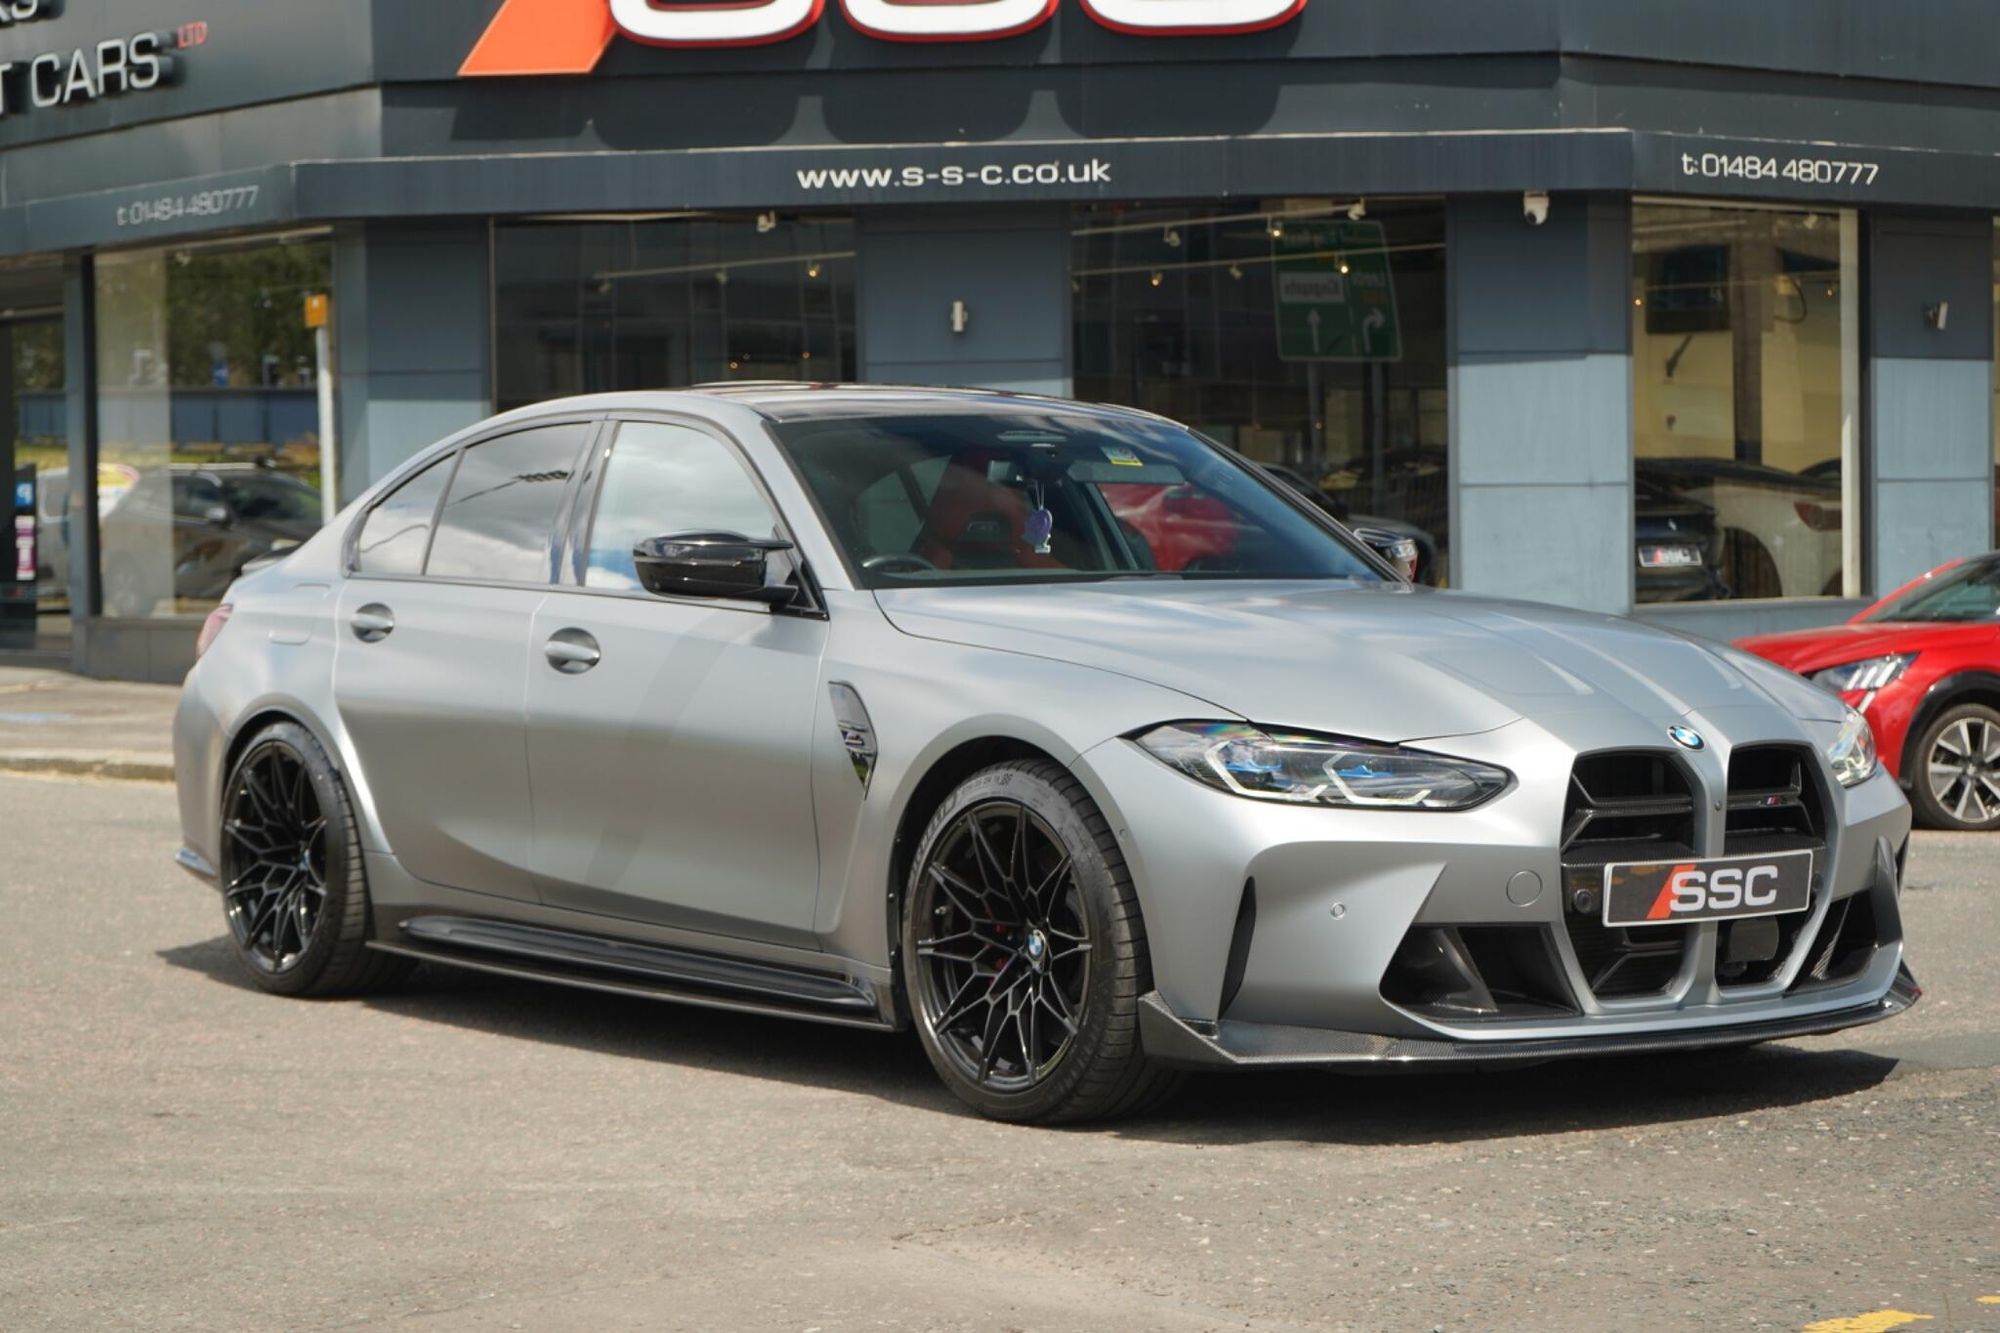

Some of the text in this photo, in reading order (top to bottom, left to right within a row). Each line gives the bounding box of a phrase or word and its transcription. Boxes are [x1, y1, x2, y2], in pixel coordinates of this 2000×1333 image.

[31, 32, 160, 108] CARS
[176, 20, 208, 49] LTD
[797, 158, 1112, 189] www.s-s-c.co.uk
[1669, 865, 1778, 912] SSC
